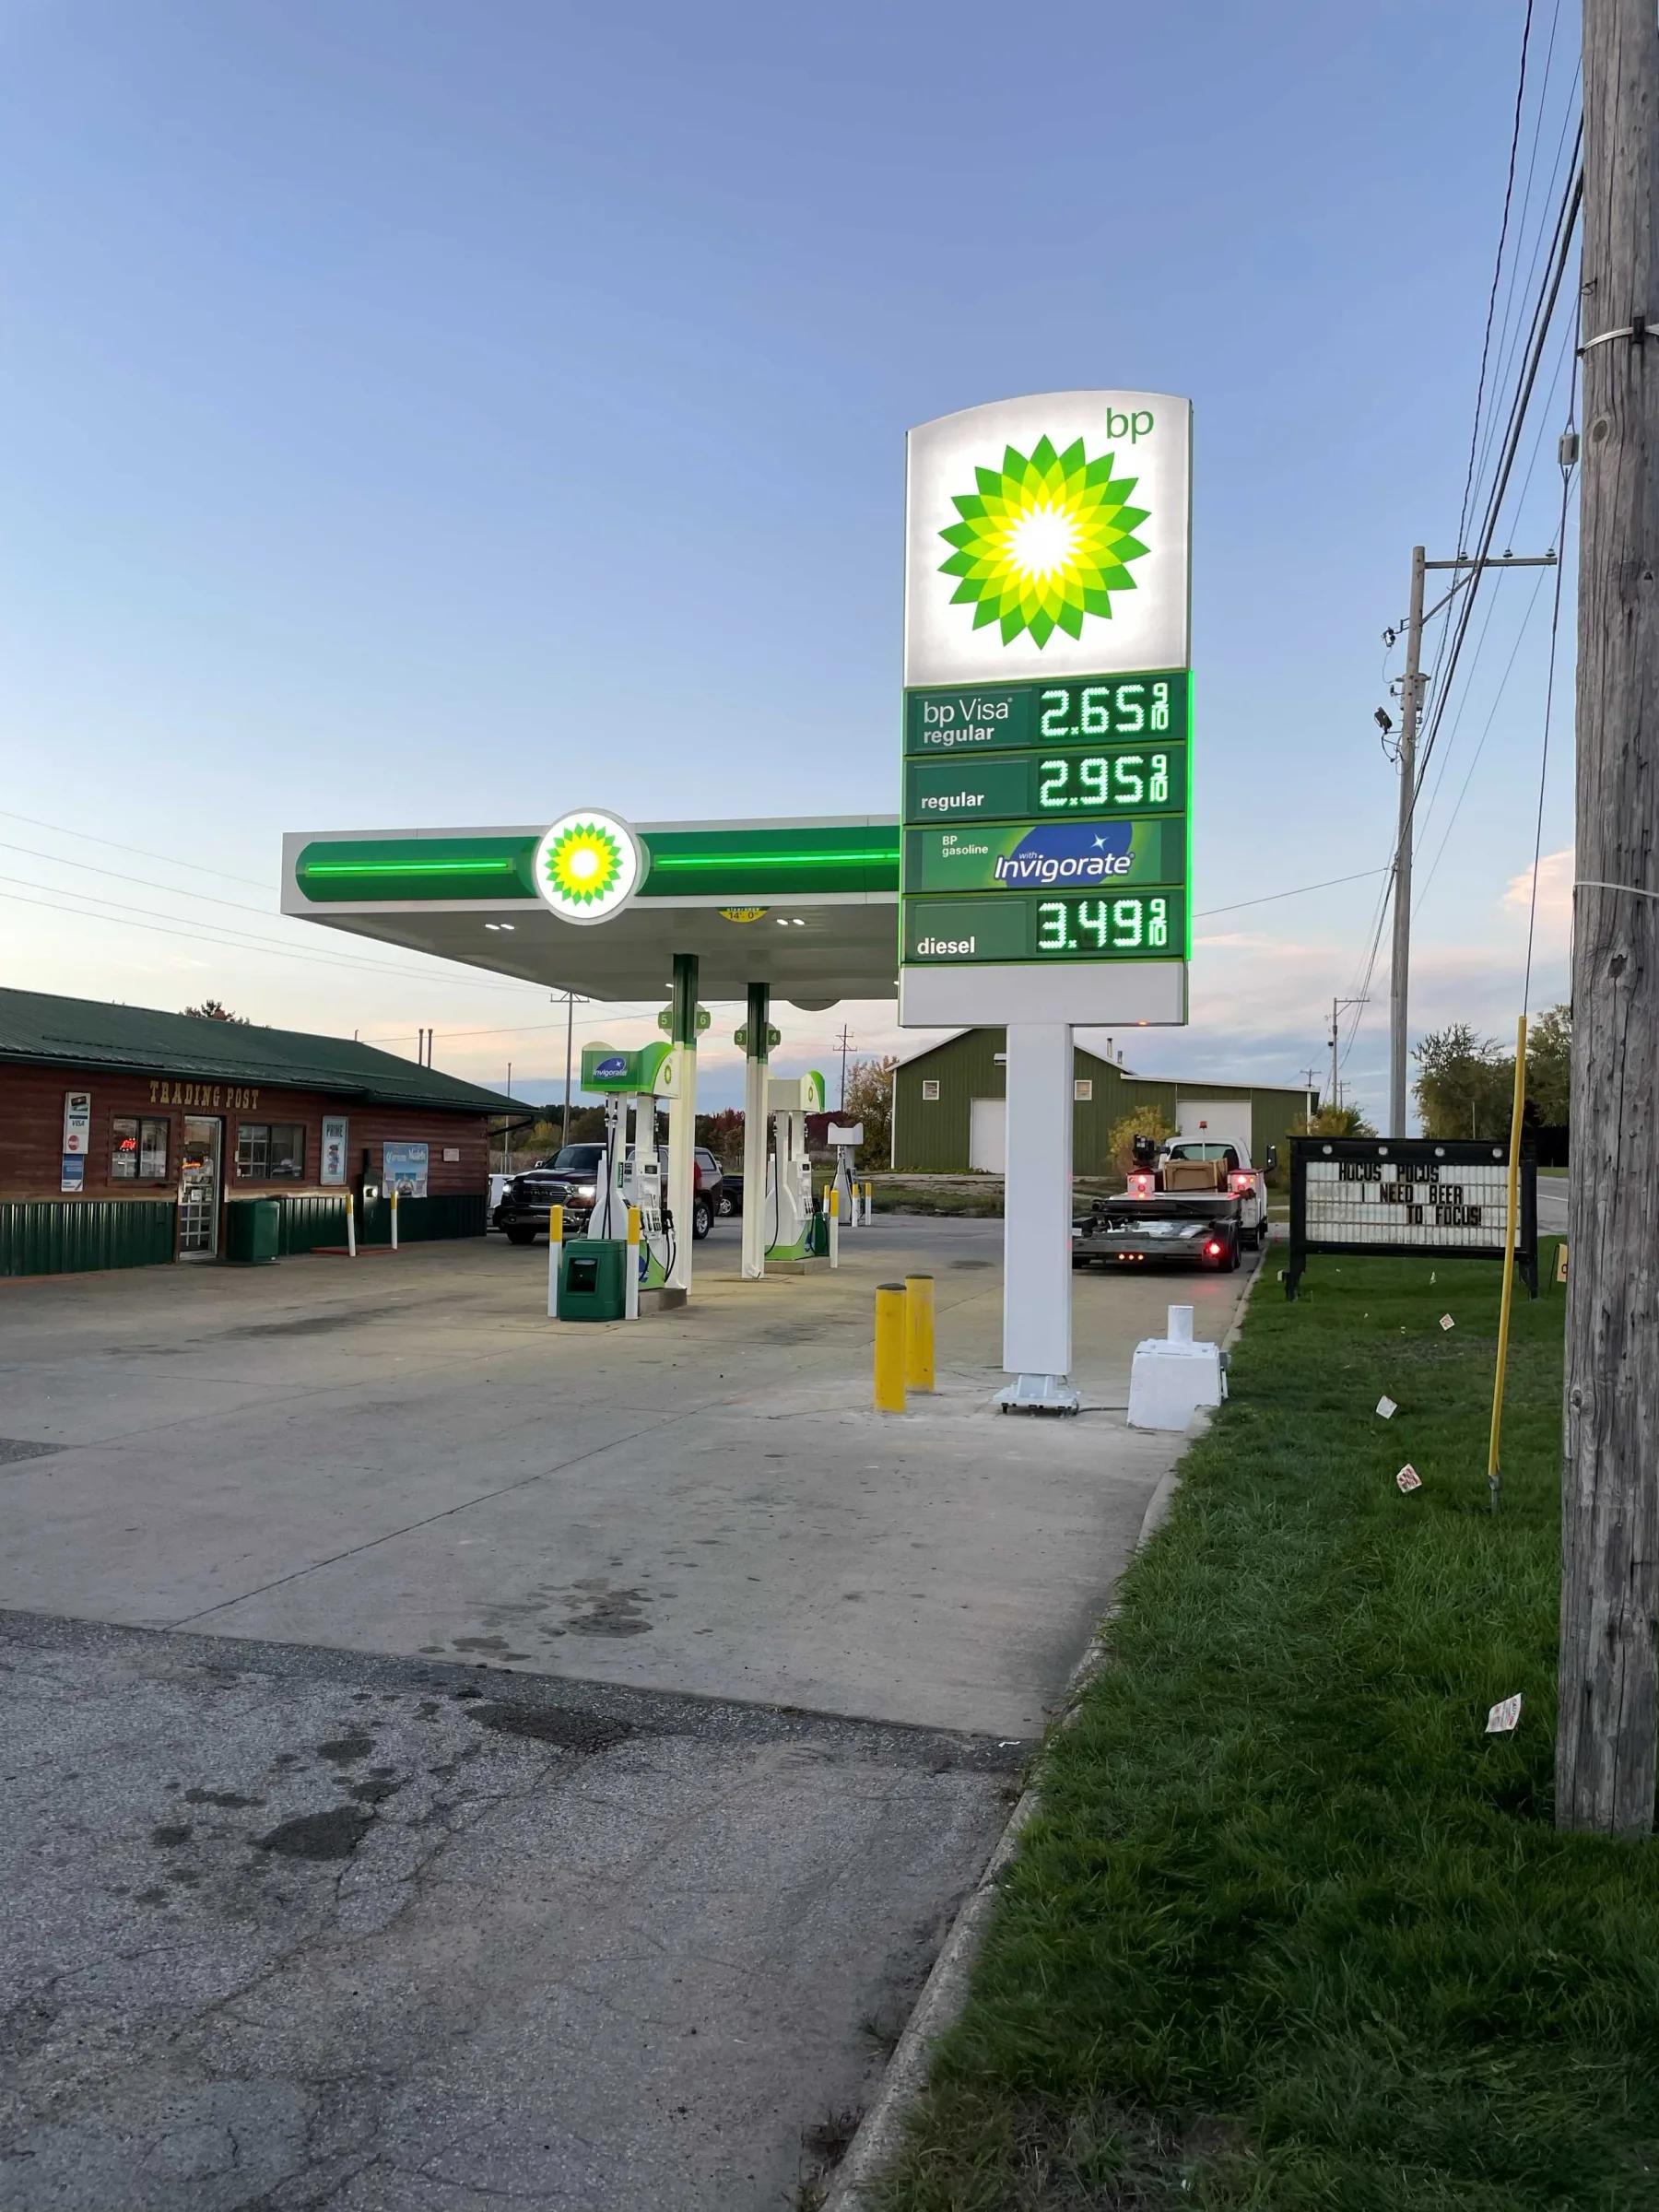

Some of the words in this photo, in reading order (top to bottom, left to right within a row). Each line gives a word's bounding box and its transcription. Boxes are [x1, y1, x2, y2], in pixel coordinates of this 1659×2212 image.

[1106, 407, 1154, 444] bp
[924, 700, 955, 725] bp
[1041, 685, 1145, 736] 2.65
[924, 724, 994, 746] regular
[922, 792, 984, 812] regular
[1040, 756, 1144, 807] 2.95
[942, 835, 958, 846] BP
[942, 844, 988, 858] gasoline
[1018, 851, 1038, 860] with
[994, 853, 1132, 883] Invigorate
[917, 936, 975, 955] diesel
[1039, 900, 1143, 949] 3.49
[661, 1014, 668, 1025] 5
[700, 1014, 707, 1025] 6
[736, 1032, 743, 1041] 3
[771, 1032, 778, 1041] 4
[149, 1080, 221, 1106] TRADING
[225, 1087, 260, 1110] POST
[1338, 1162, 1382, 1182] HOCUS
[1396, 1164, 1440, 1182] POCUS
[1380, 1183, 1414, 1203] NEED
[1430, 1185, 1464, 1205] BEER
[1407, 1205, 1423, 1225] TO
[1435, 1206, 1482, 1226] FOCUS!
